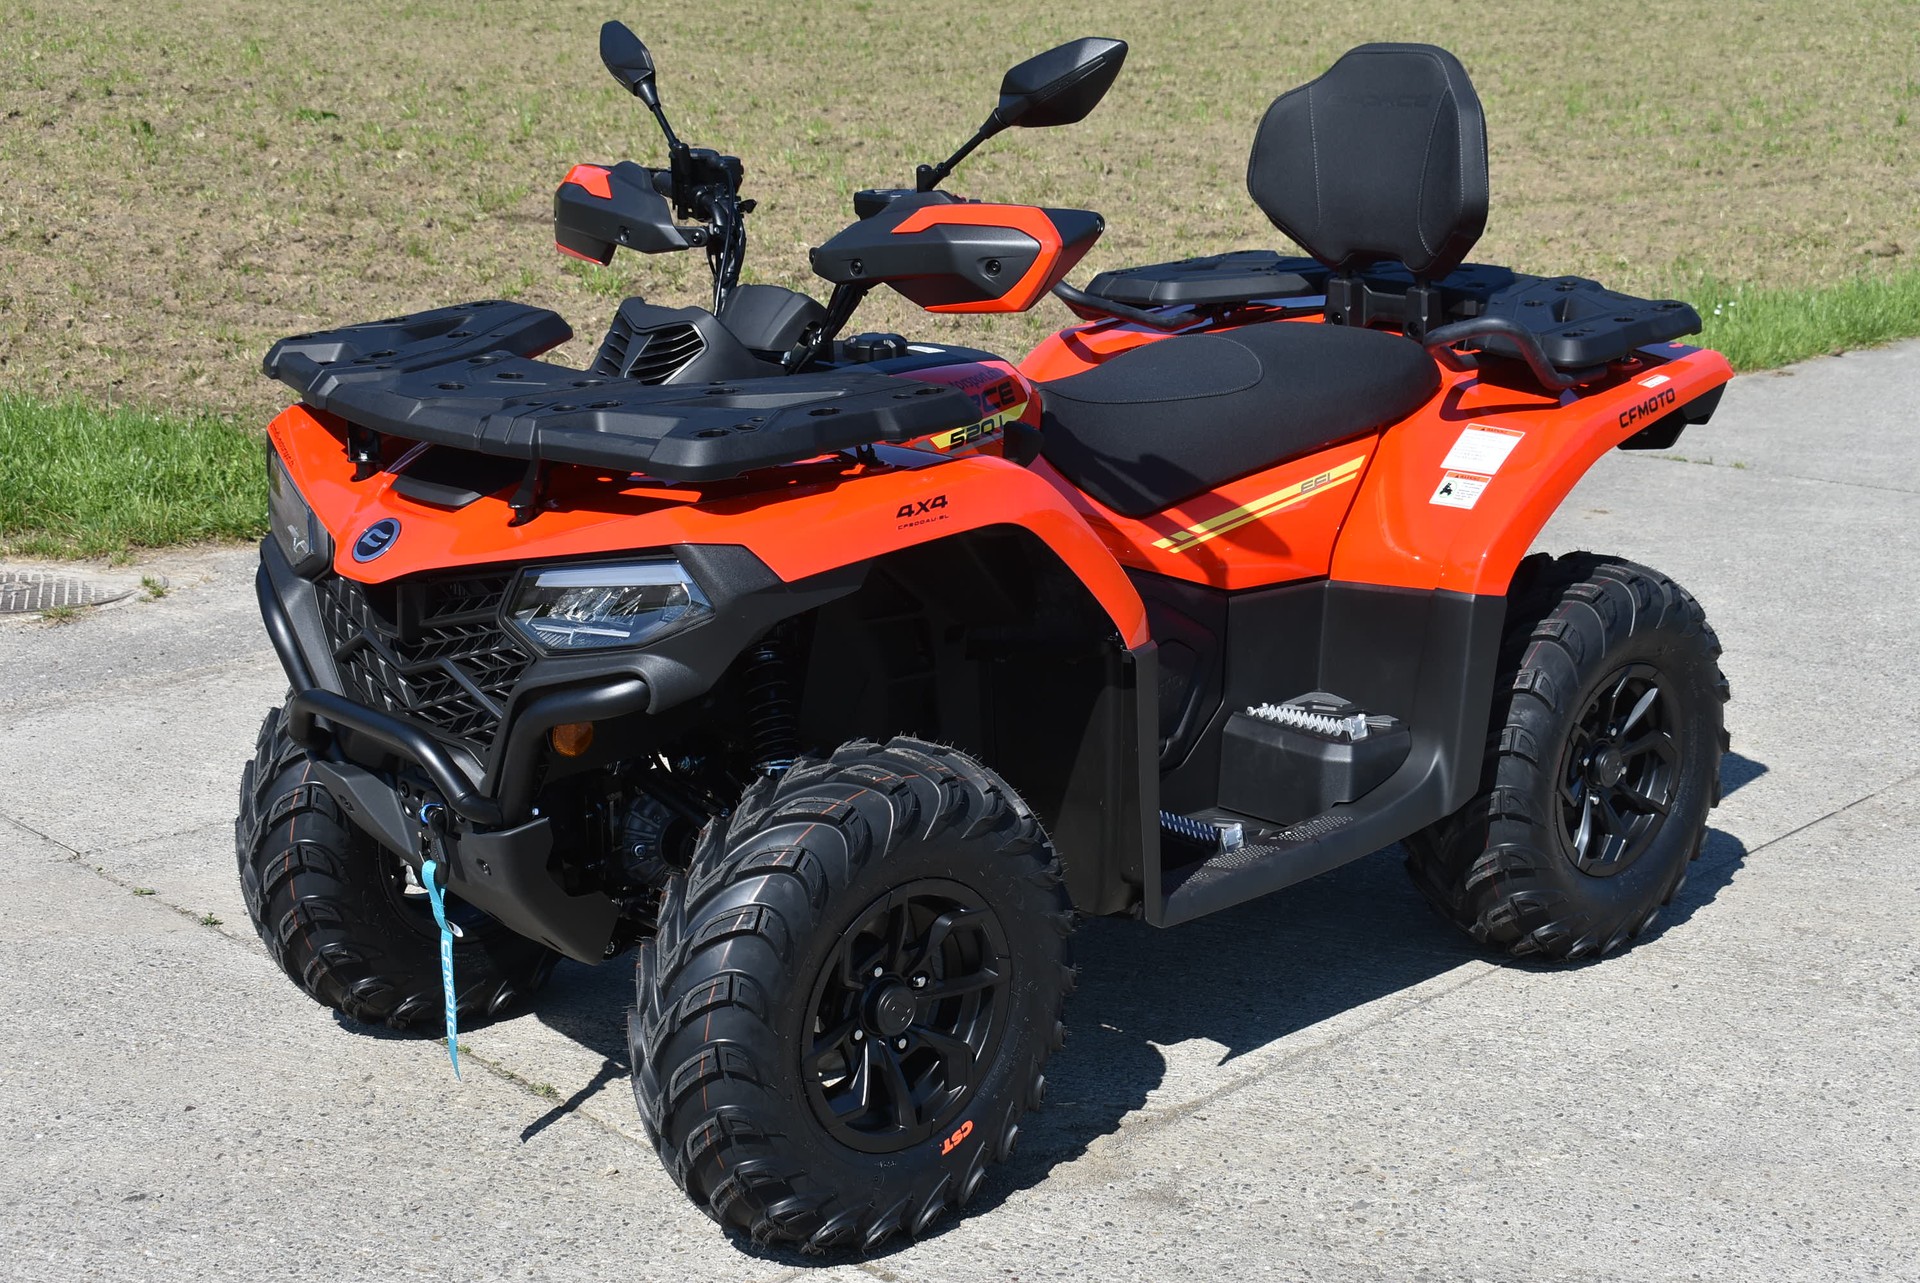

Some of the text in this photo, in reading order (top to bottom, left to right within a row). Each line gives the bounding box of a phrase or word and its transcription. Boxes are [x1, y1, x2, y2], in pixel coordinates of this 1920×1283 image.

[1618, 387, 1676, 429] CFMOTO
[1300, 471, 1332, 494] EFI
[441, 940, 456, 1040] CFMOTO
[941, 1119, 975, 1156] CST
